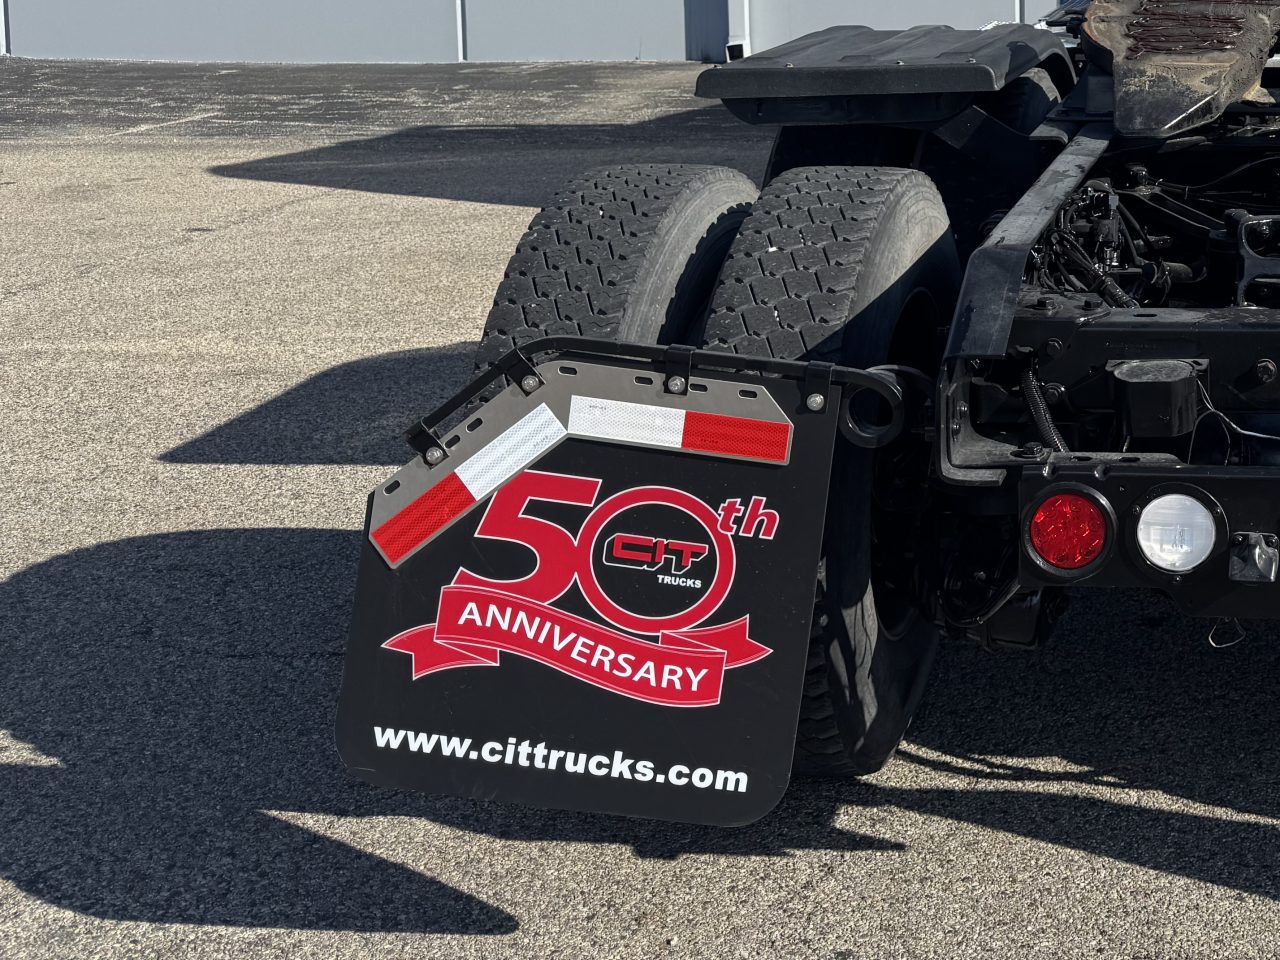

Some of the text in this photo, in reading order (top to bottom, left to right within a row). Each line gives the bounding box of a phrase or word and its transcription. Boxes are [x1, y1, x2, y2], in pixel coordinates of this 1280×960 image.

[611, 533, 710, 568] CIT
[657, 574, 702, 589] TRUCKS
[457, 601, 710, 693] ANNIVERSARY
[373, 726, 749, 793] www.cittrucks.com
